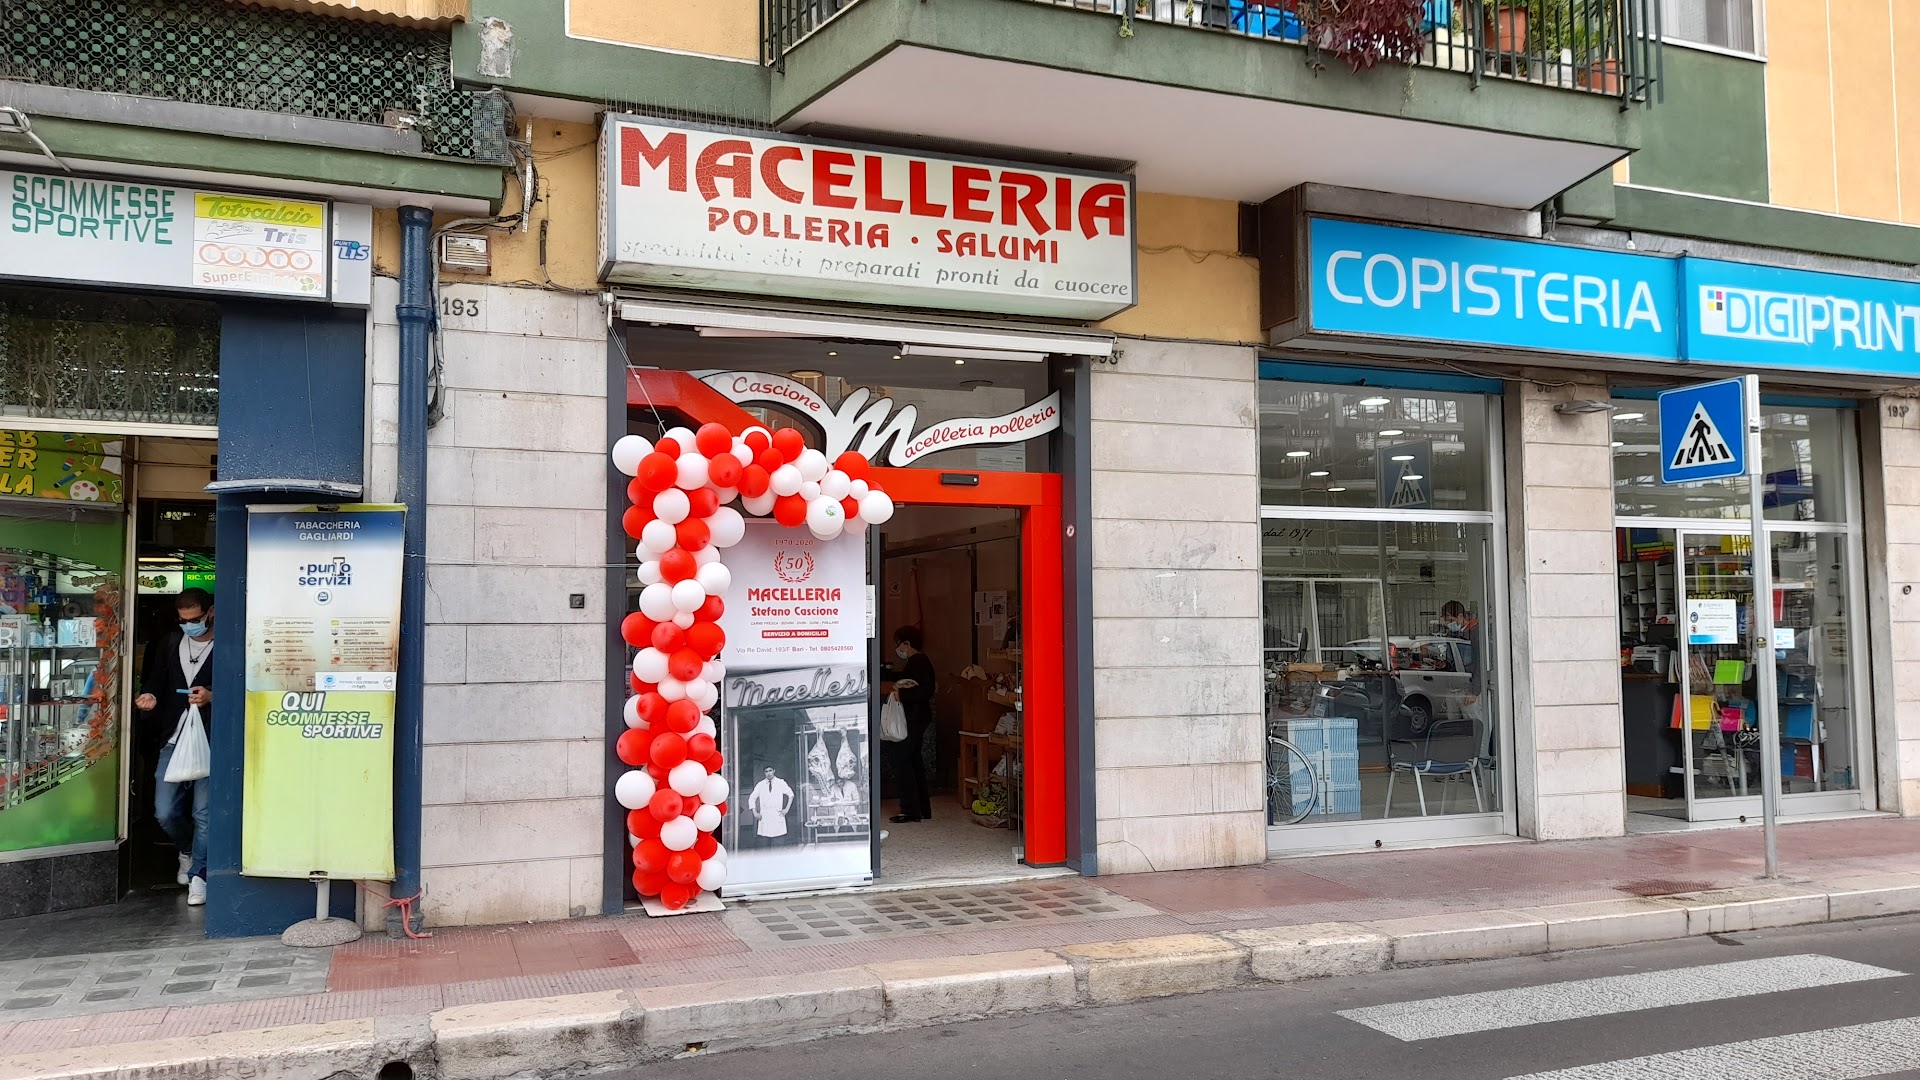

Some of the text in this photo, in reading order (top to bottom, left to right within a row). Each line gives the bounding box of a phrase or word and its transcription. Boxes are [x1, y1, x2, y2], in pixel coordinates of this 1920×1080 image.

[620, 126, 1126, 240] MACELLERIA
[12, 175, 175, 219] SCOMMESSE
[202, 196, 313, 224] Totocalcio
[11, 203, 174, 245] SPORTIVE
[263, 227, 307, 244] Tris
[707, 207, 1059, 264] POLLERIA SALUMI
[819, 256, 921, 280] preparati
[935, 266, 1000, 288] pronti
[1014, 269, 1040, 290] da
[1054, 279, 1129, 297] cuocere
[1326, 249, 1662, 334] COPISTERIA
[441, 297, 479, 316] 193
[1725, 292, 1920, 352] DIGIPRINT
[731, 375, 822, 412] Cascione
[989, 405, 1056, 439] polleria
[294, 521, 361, 530] TABACCHERIA
[1288, 528, 1313, 541] 1971
[299, 532, 354, 541] GAGLIARDI
[795, 538, 814, 546] 2020
[785, 557, 804, 570] 50
[298, 574, 352, 586] servizi
[747, 587, 841, 602] MACELLERIA
[751, 606, 839, 616] Stefano Cascione
[281, 691, 326, 712] QUI
[267, 710, 370, 726] SCOMMESSE
[302, 723, 383, 739] SPORTIVE
